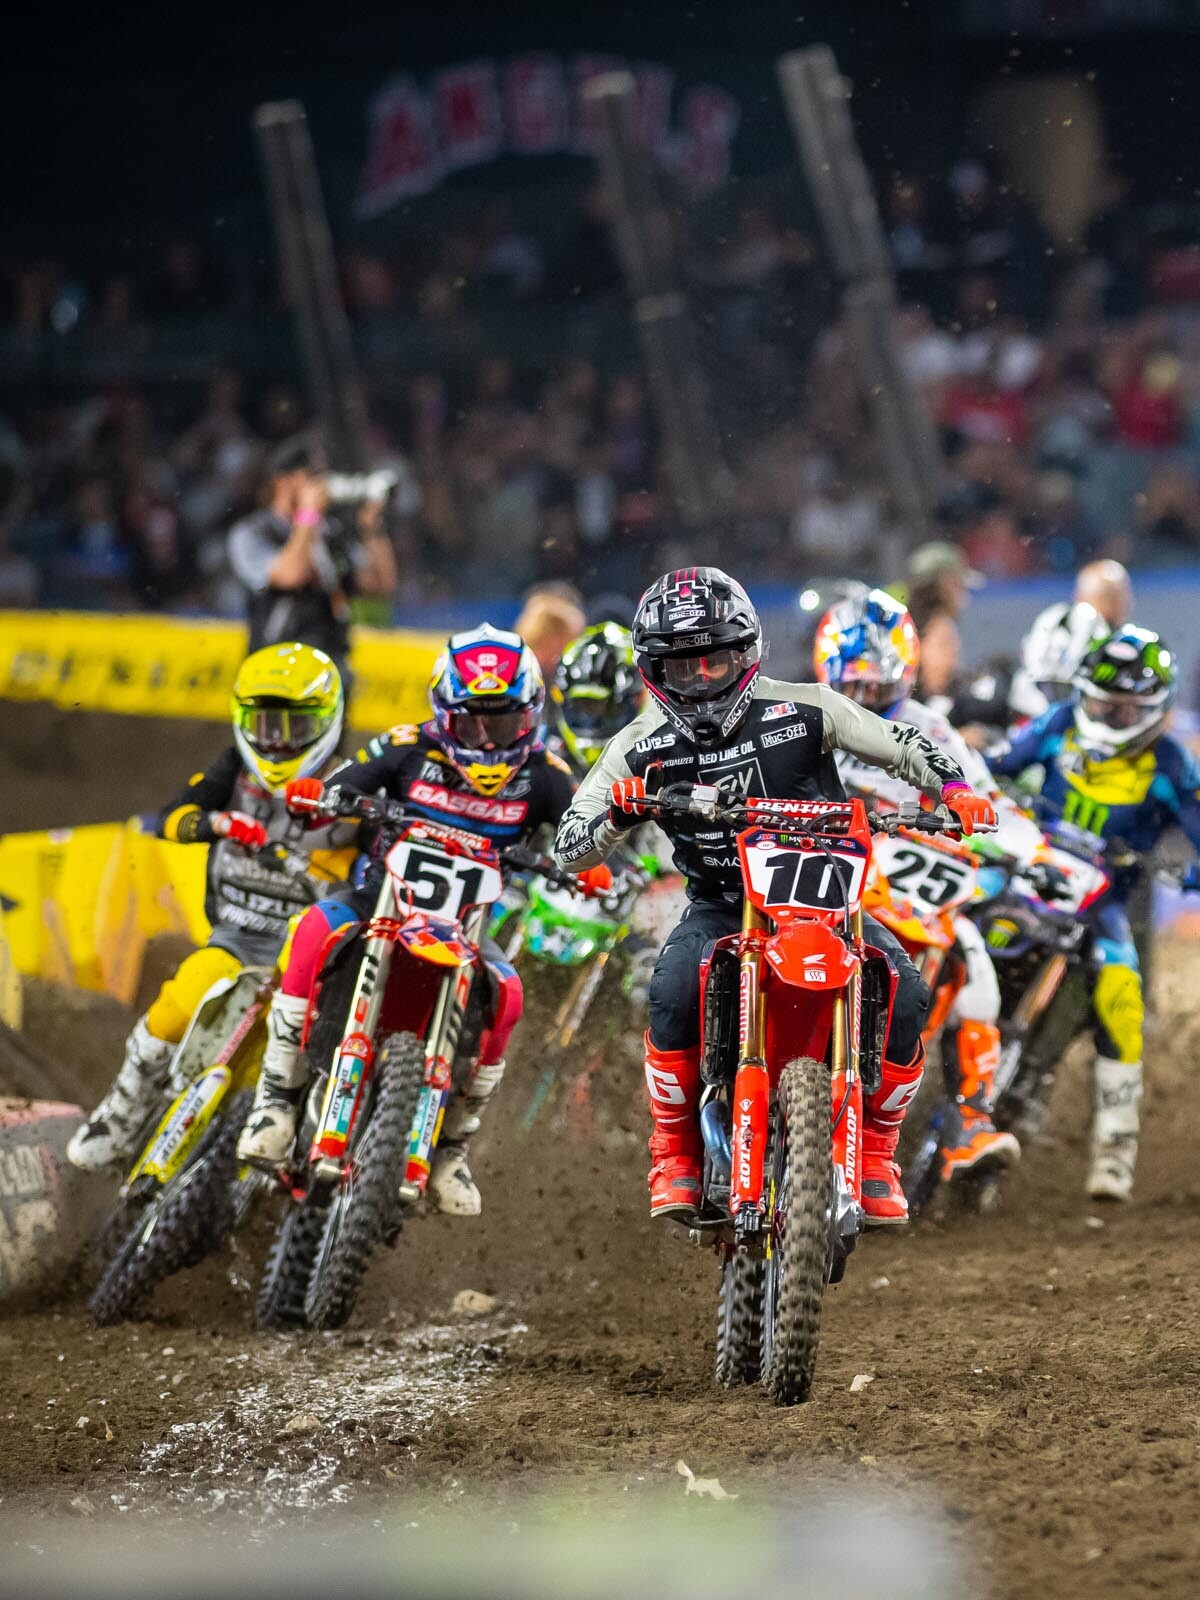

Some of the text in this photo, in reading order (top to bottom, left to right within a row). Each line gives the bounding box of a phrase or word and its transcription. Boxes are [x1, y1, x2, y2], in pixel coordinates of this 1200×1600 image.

[762, 702, 798, 720] AMA
[699, 740, 756, 766] RED LINE OIL
[762, 724, 807, 747] Muc-Off
[410, 783, 526, 822] GASGAS
[755, 801, 852, 814] RENTHAL
[400, 848, 485, 918] 51
[765, 852, 855, 909] 10
[887, 850, 967, 906] 25
[845, 1106, 858, 1183] DUNLOP
